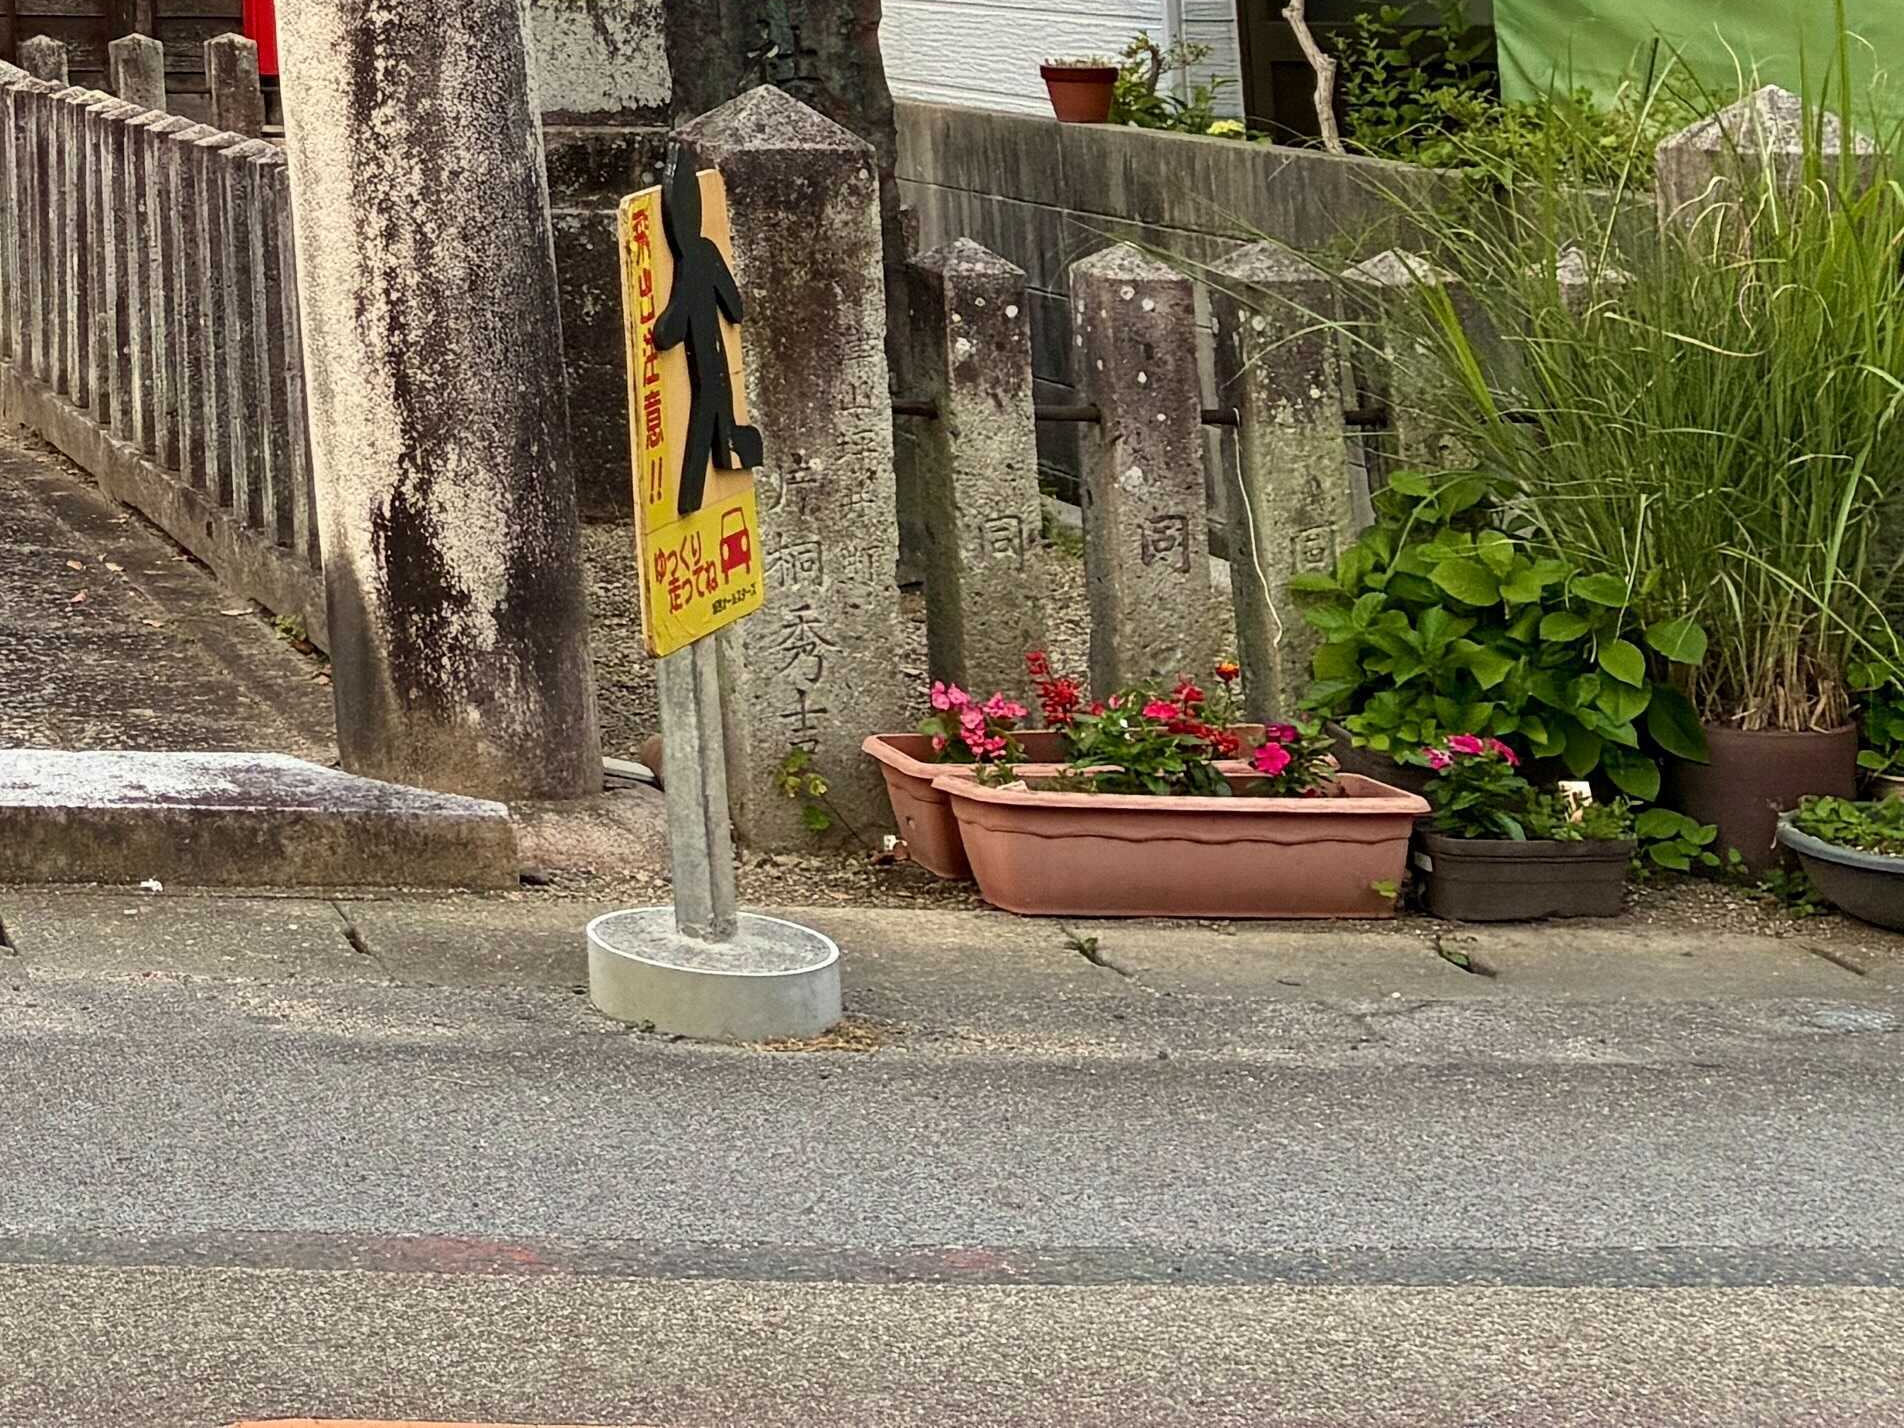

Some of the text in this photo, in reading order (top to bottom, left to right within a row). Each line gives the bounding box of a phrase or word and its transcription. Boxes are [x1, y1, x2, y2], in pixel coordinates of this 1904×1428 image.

[654, 531, 702, 585] ゆっくり
[980, 514, 1024, 570] 同
[1139, 514, 1191, 573] 同
[667, 559, 719, 615] 走ってね
[763, 452, 837, 756] 片桐秀吉
